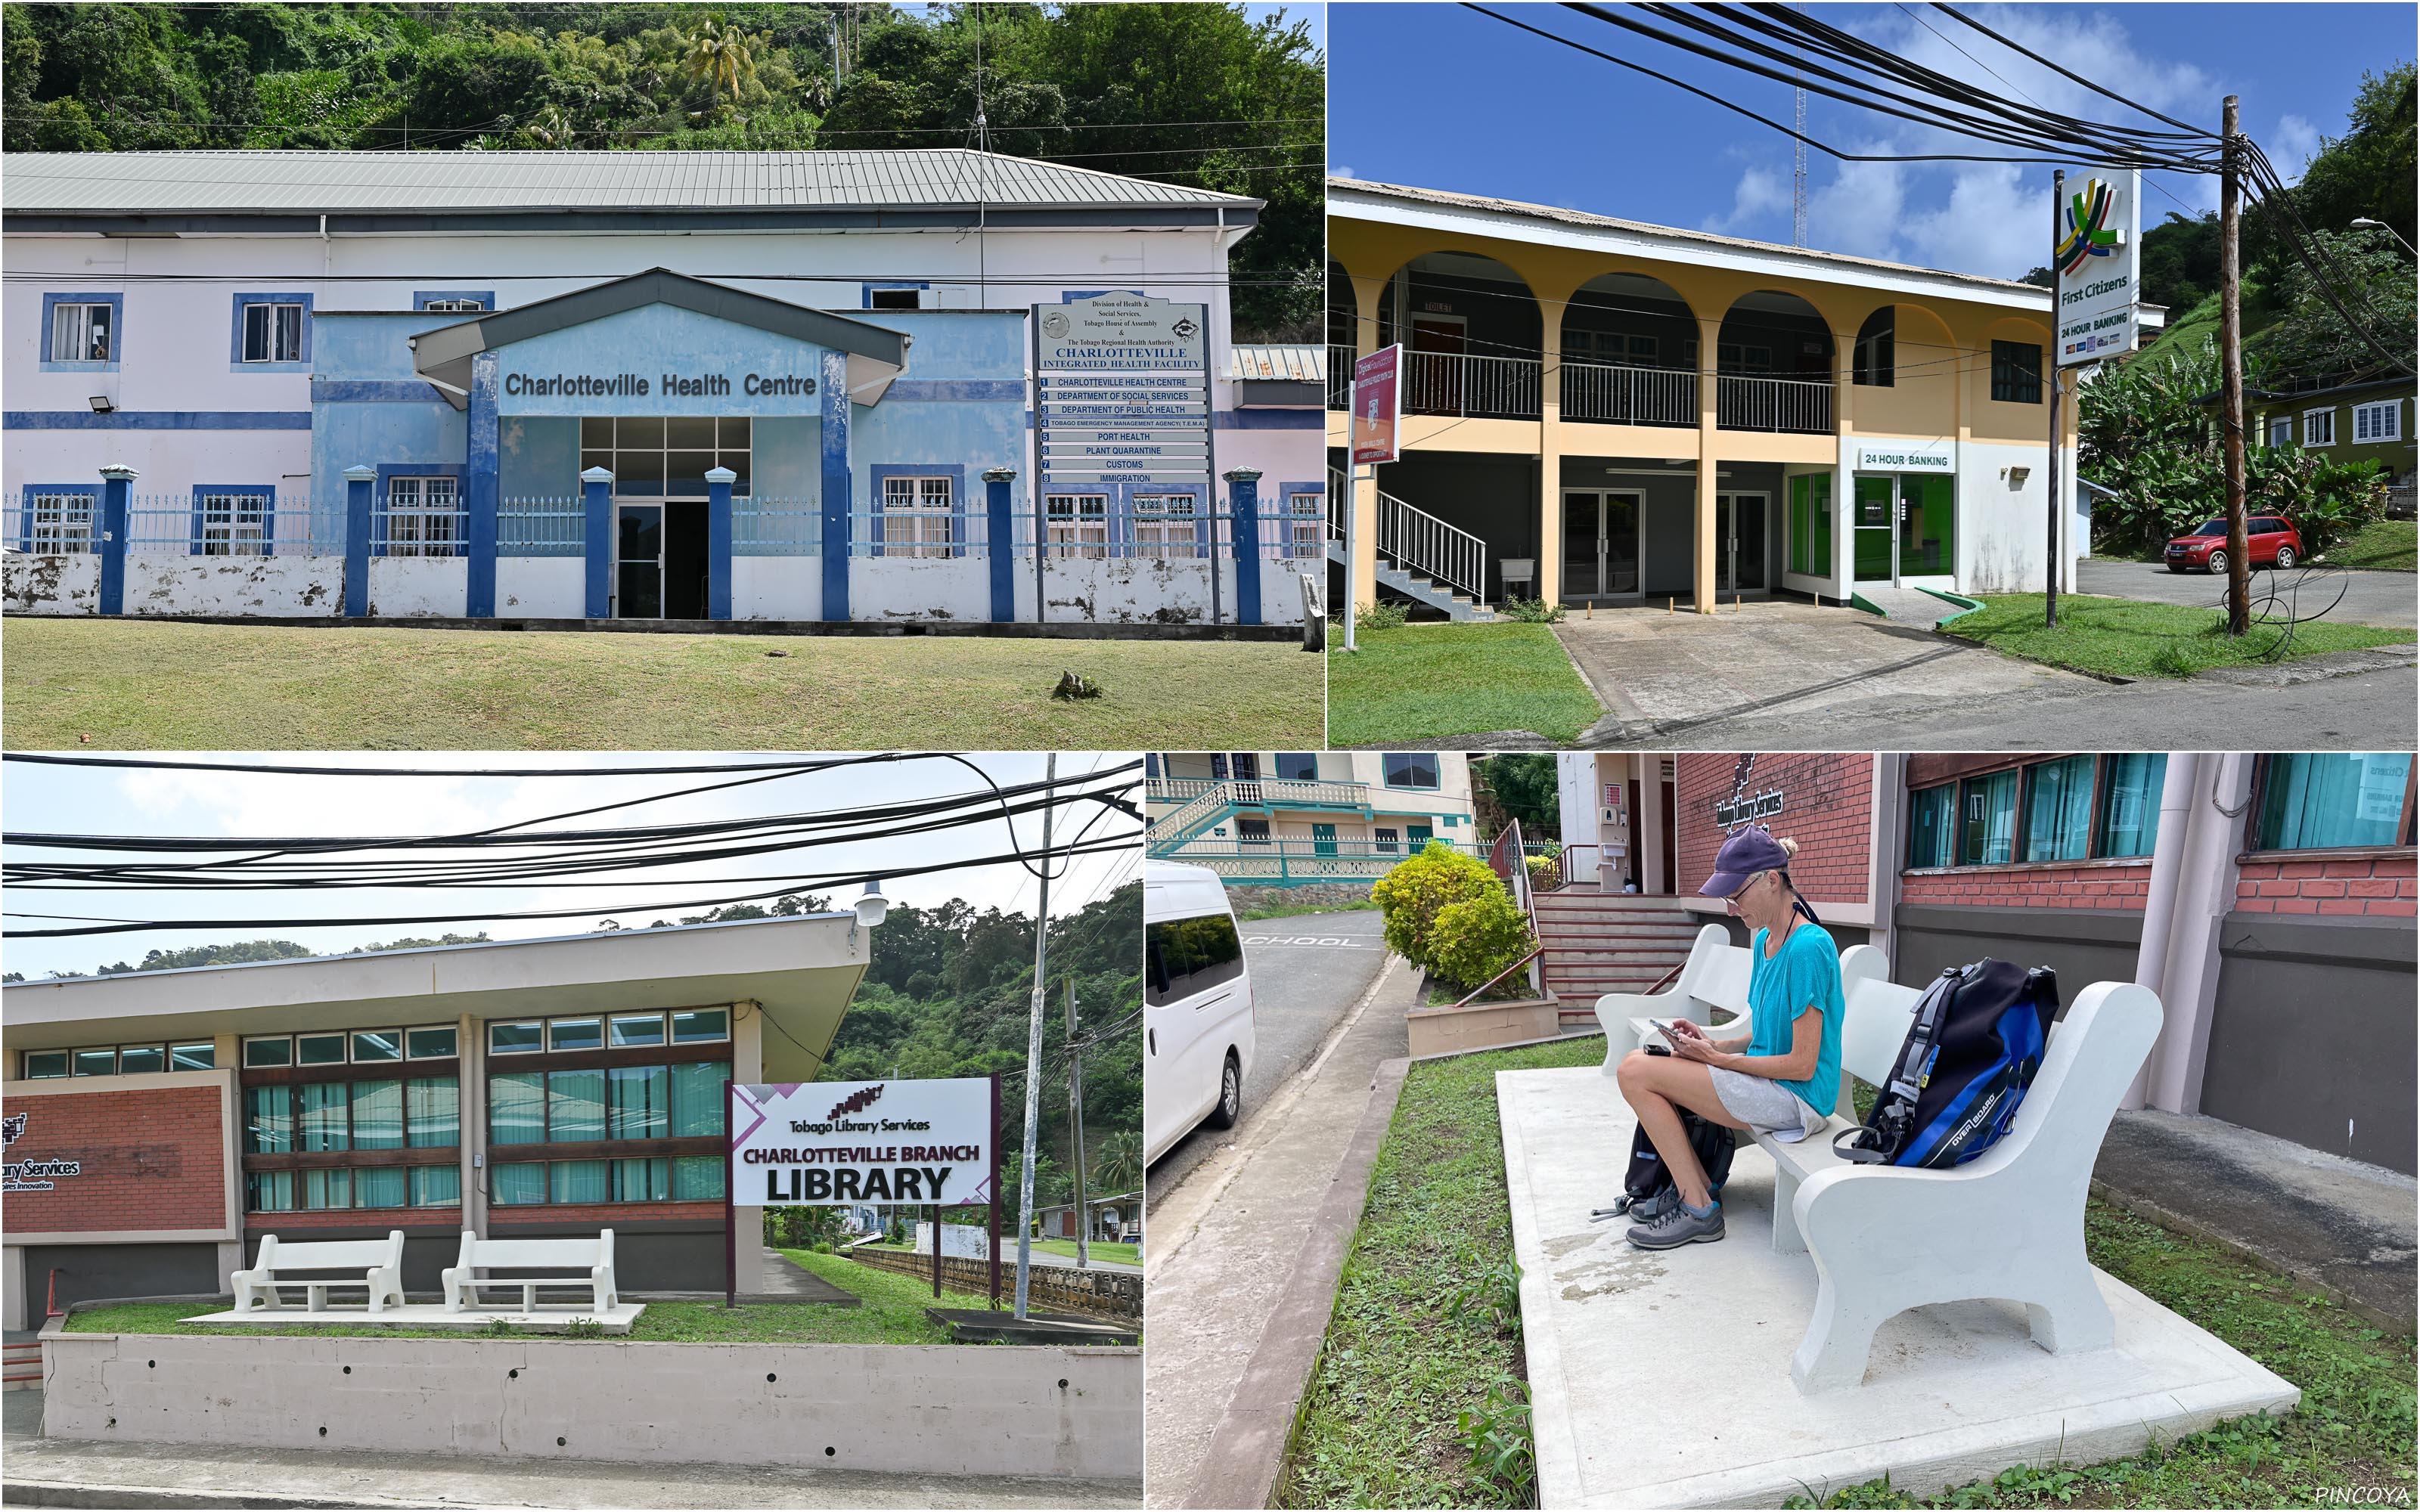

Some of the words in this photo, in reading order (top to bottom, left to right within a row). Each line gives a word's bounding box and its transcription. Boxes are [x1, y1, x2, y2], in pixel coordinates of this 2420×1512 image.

[2062, 289, 2083, 307] First
[2085, 276, 2127, 298] Citizens
[1426, 302, 1452, 311] TOILET
[2062, 328, 2069, 338] 24
[2071, 322, 2091, 336] HOUR
[2094, 313, 2127, 330] BANKING
[1056, 348, 1187, 358] CHARLOTTEVILLE
[505, 373, 649, 396] Charlotteville
[662, 374, 730, 395] Health
[744, 373, 816, 396] Centre
[1865, 454, 1877, 463] 24
[1879, 455, 1904, 464] HOUR
[1909, 456, 1947, 466] BANKING
[1717, 801, 1734, 828] Tobago
[1734, 797, 1755, 823] Library
[1755, 790, 1781, 815] Services
[789, 1120, 833, 1135] Tobago
[835, 1119, 879, 1134] Library
[880, 1118, 930, 1131] Services
[743, 1146, 897, 1164] CHARLOTTEVILLE
[901, 1145, 980, 1162] BRANCH
[24, 1160, 79, 1176] Services
[767, 1167, 952, 1201] LIBRARY
